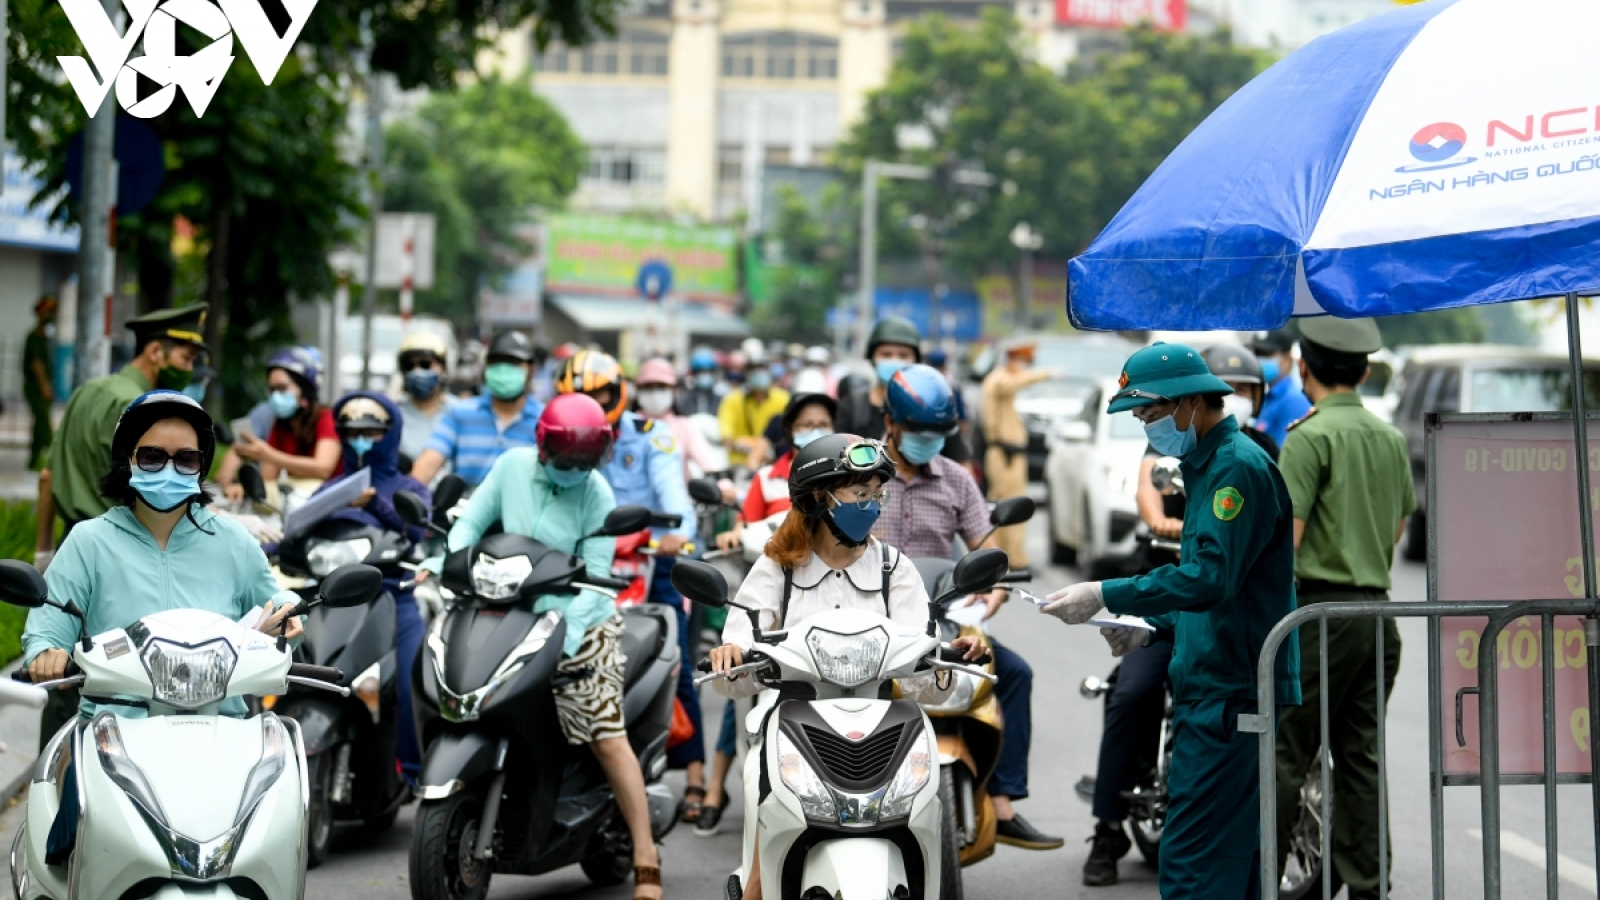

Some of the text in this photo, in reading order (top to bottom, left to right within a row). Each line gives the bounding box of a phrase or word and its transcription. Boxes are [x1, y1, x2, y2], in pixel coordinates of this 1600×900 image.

[1486, 105, 1600, 148] NC
[1484, 143, 1547, 158] NATIONAL
[1369, 153, 1600, 200] NGÂN HÀNG QUỐ
